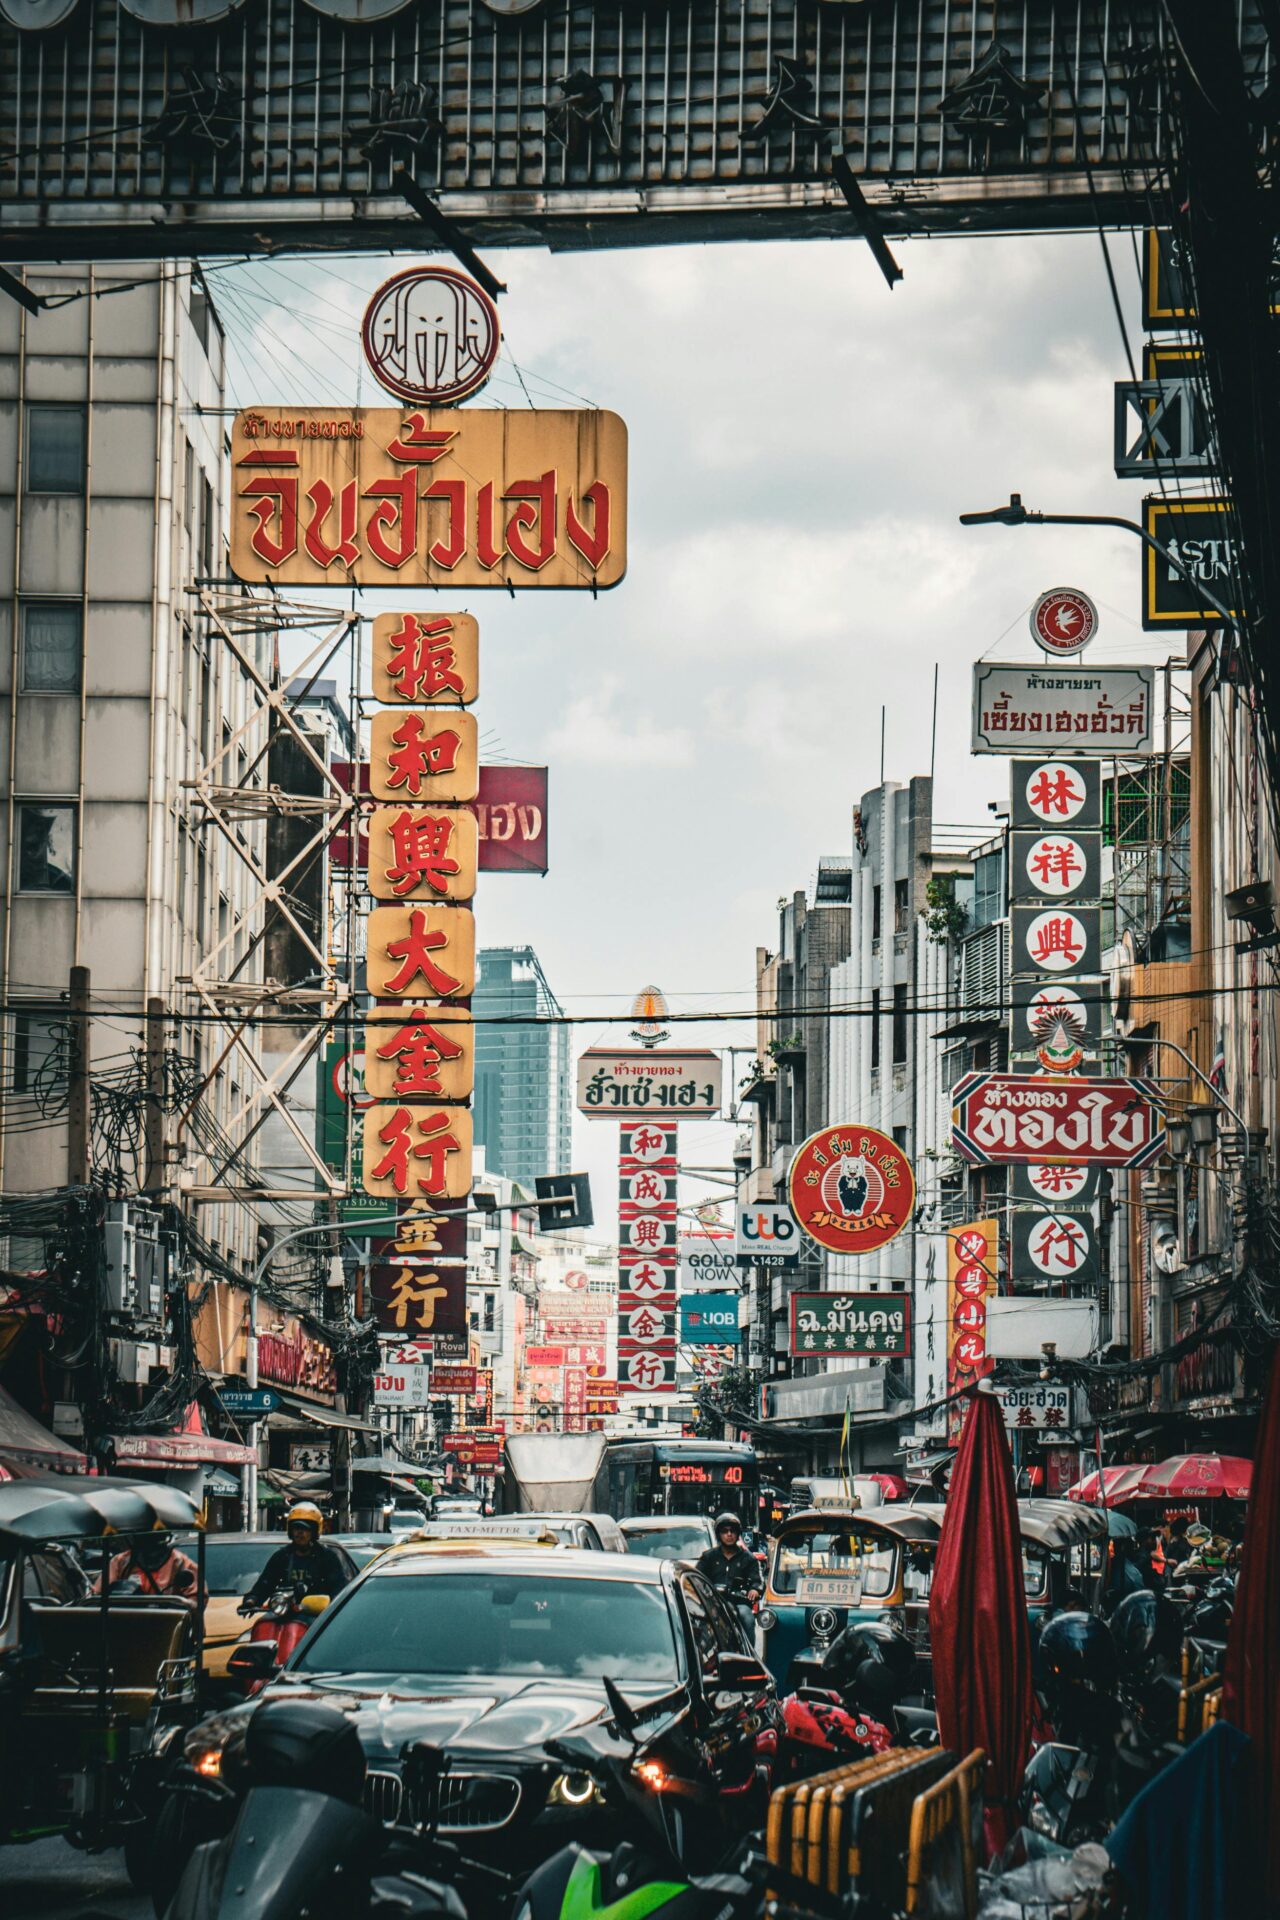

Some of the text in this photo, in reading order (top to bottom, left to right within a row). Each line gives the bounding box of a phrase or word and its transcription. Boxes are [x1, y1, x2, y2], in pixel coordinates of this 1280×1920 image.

[243, 412, 364, 440] ห้างขายทอง
[1026, 674, 1102, 690] ห้างขายยา
[984, 1084, 1068, 1107] ห้างทอง
[973, 1091, 1144, 1151] ทองใบ
[337, 1197, 388, 1207] ISDOM
[742, 1213, 794, 1240] ttb
[629, 1127, 664, 1386] 和成興大金行
[688, 1254, 735, 1268] GOLD
[760, 1256, 785, 1266] 1428
[693, 1268, 730, 1281] NOW
[702, 1312, 735, 1325] UOB
[262, 1394, 271, 1406] 6
[724, 1466, 743, 1483] 40
[1182, 1485, 1208, 1496] Coca-Cola
[820, 1499, 851, 1508] TAXI
[449, 1525, 520, 1535] TAXI-METER
[828, 1583, 855, 1594] 5121
